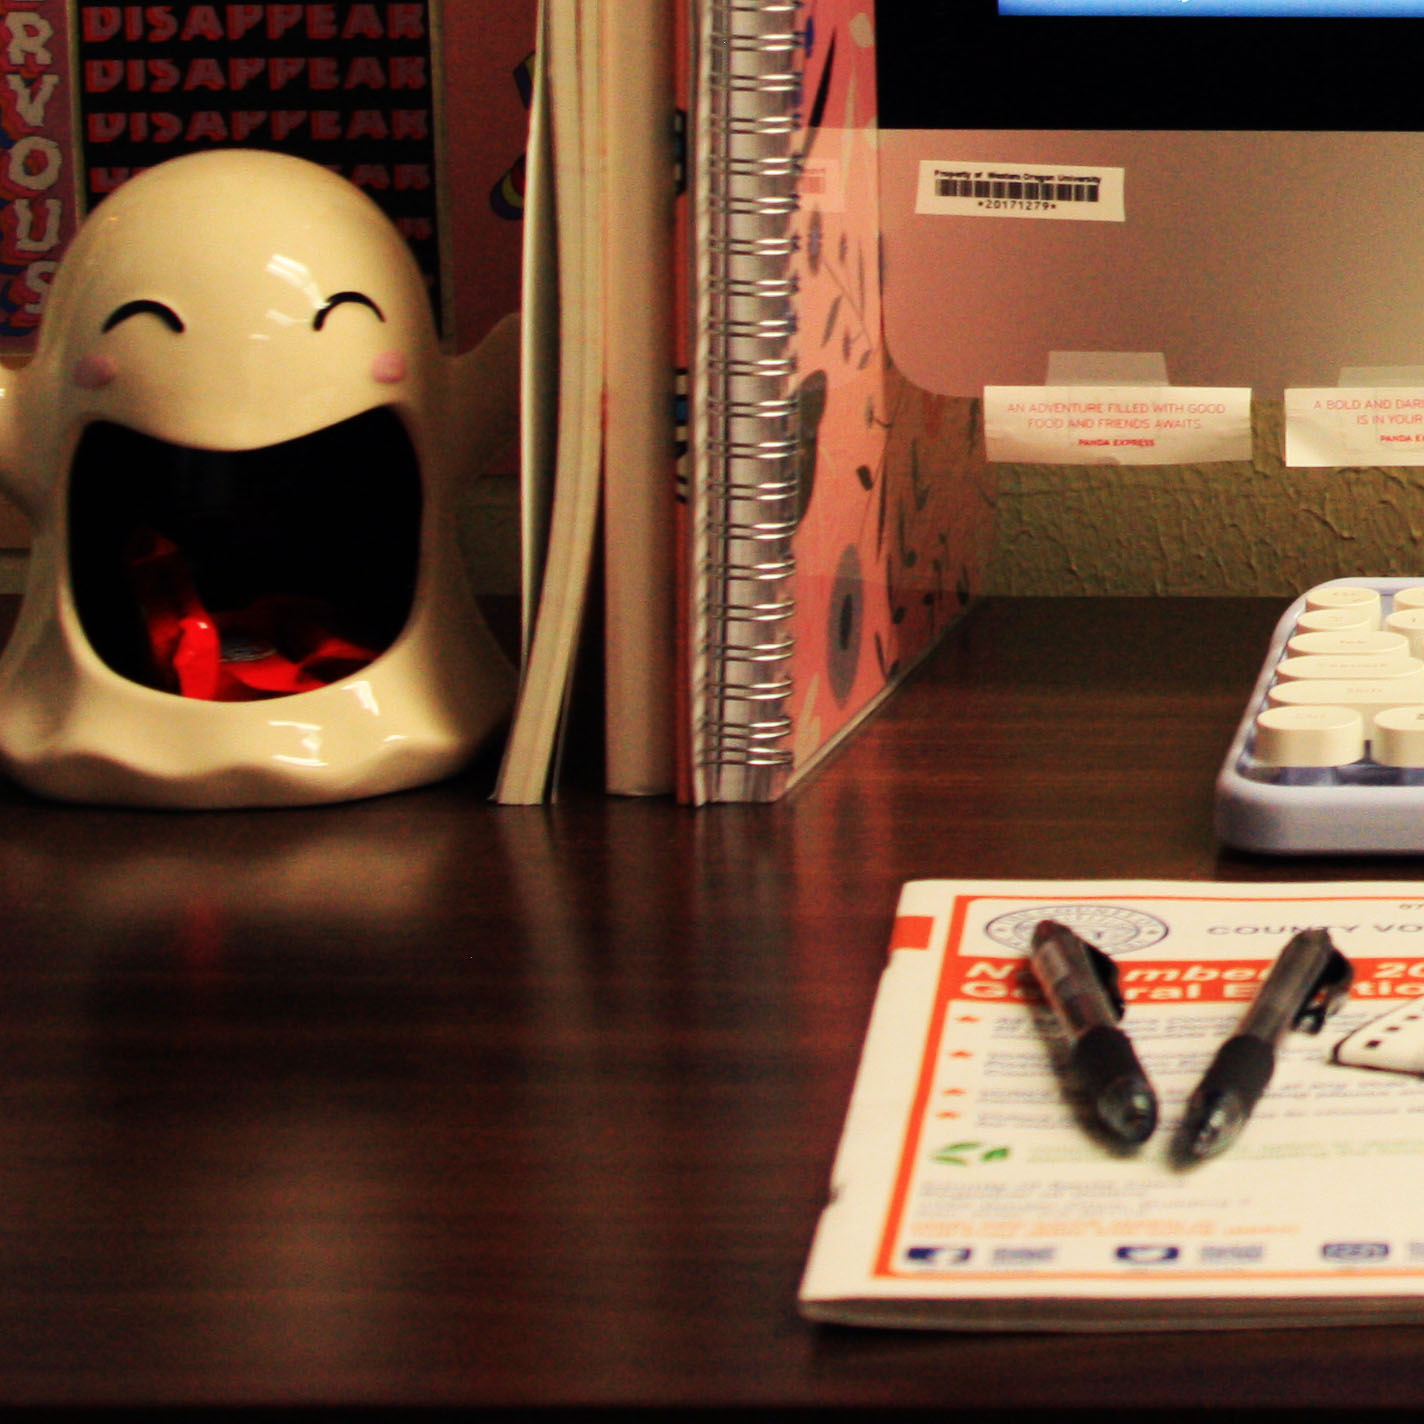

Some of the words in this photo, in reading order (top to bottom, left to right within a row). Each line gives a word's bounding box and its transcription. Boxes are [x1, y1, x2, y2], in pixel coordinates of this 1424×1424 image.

[83, 4, 424, 42] DISAPPEAR
[1007, 403, 1026, 413] AN
[1029, 403, 1103, 414] ADVENTURE
[1108, 403, 1149, 414] FILLED
[1153, 403, 1184, 414] WITH
[1187, 403, 1225, 414] GOOD
[1314, 400, 1322, 410] A
[1327, 400, 1361, 410] BOLD
[1365, 399, 1391, 409] AND
[1028, 419, 1064, 429] FOOD
[1067, 419, 1094, 429] AND
[1099, 419, 1150, 429] FRIENDS
[1356, 415, 1368, 425] IS
[1372, 415, 1385, 424] IN
[1389, 414, 1423, 424] YOUR
